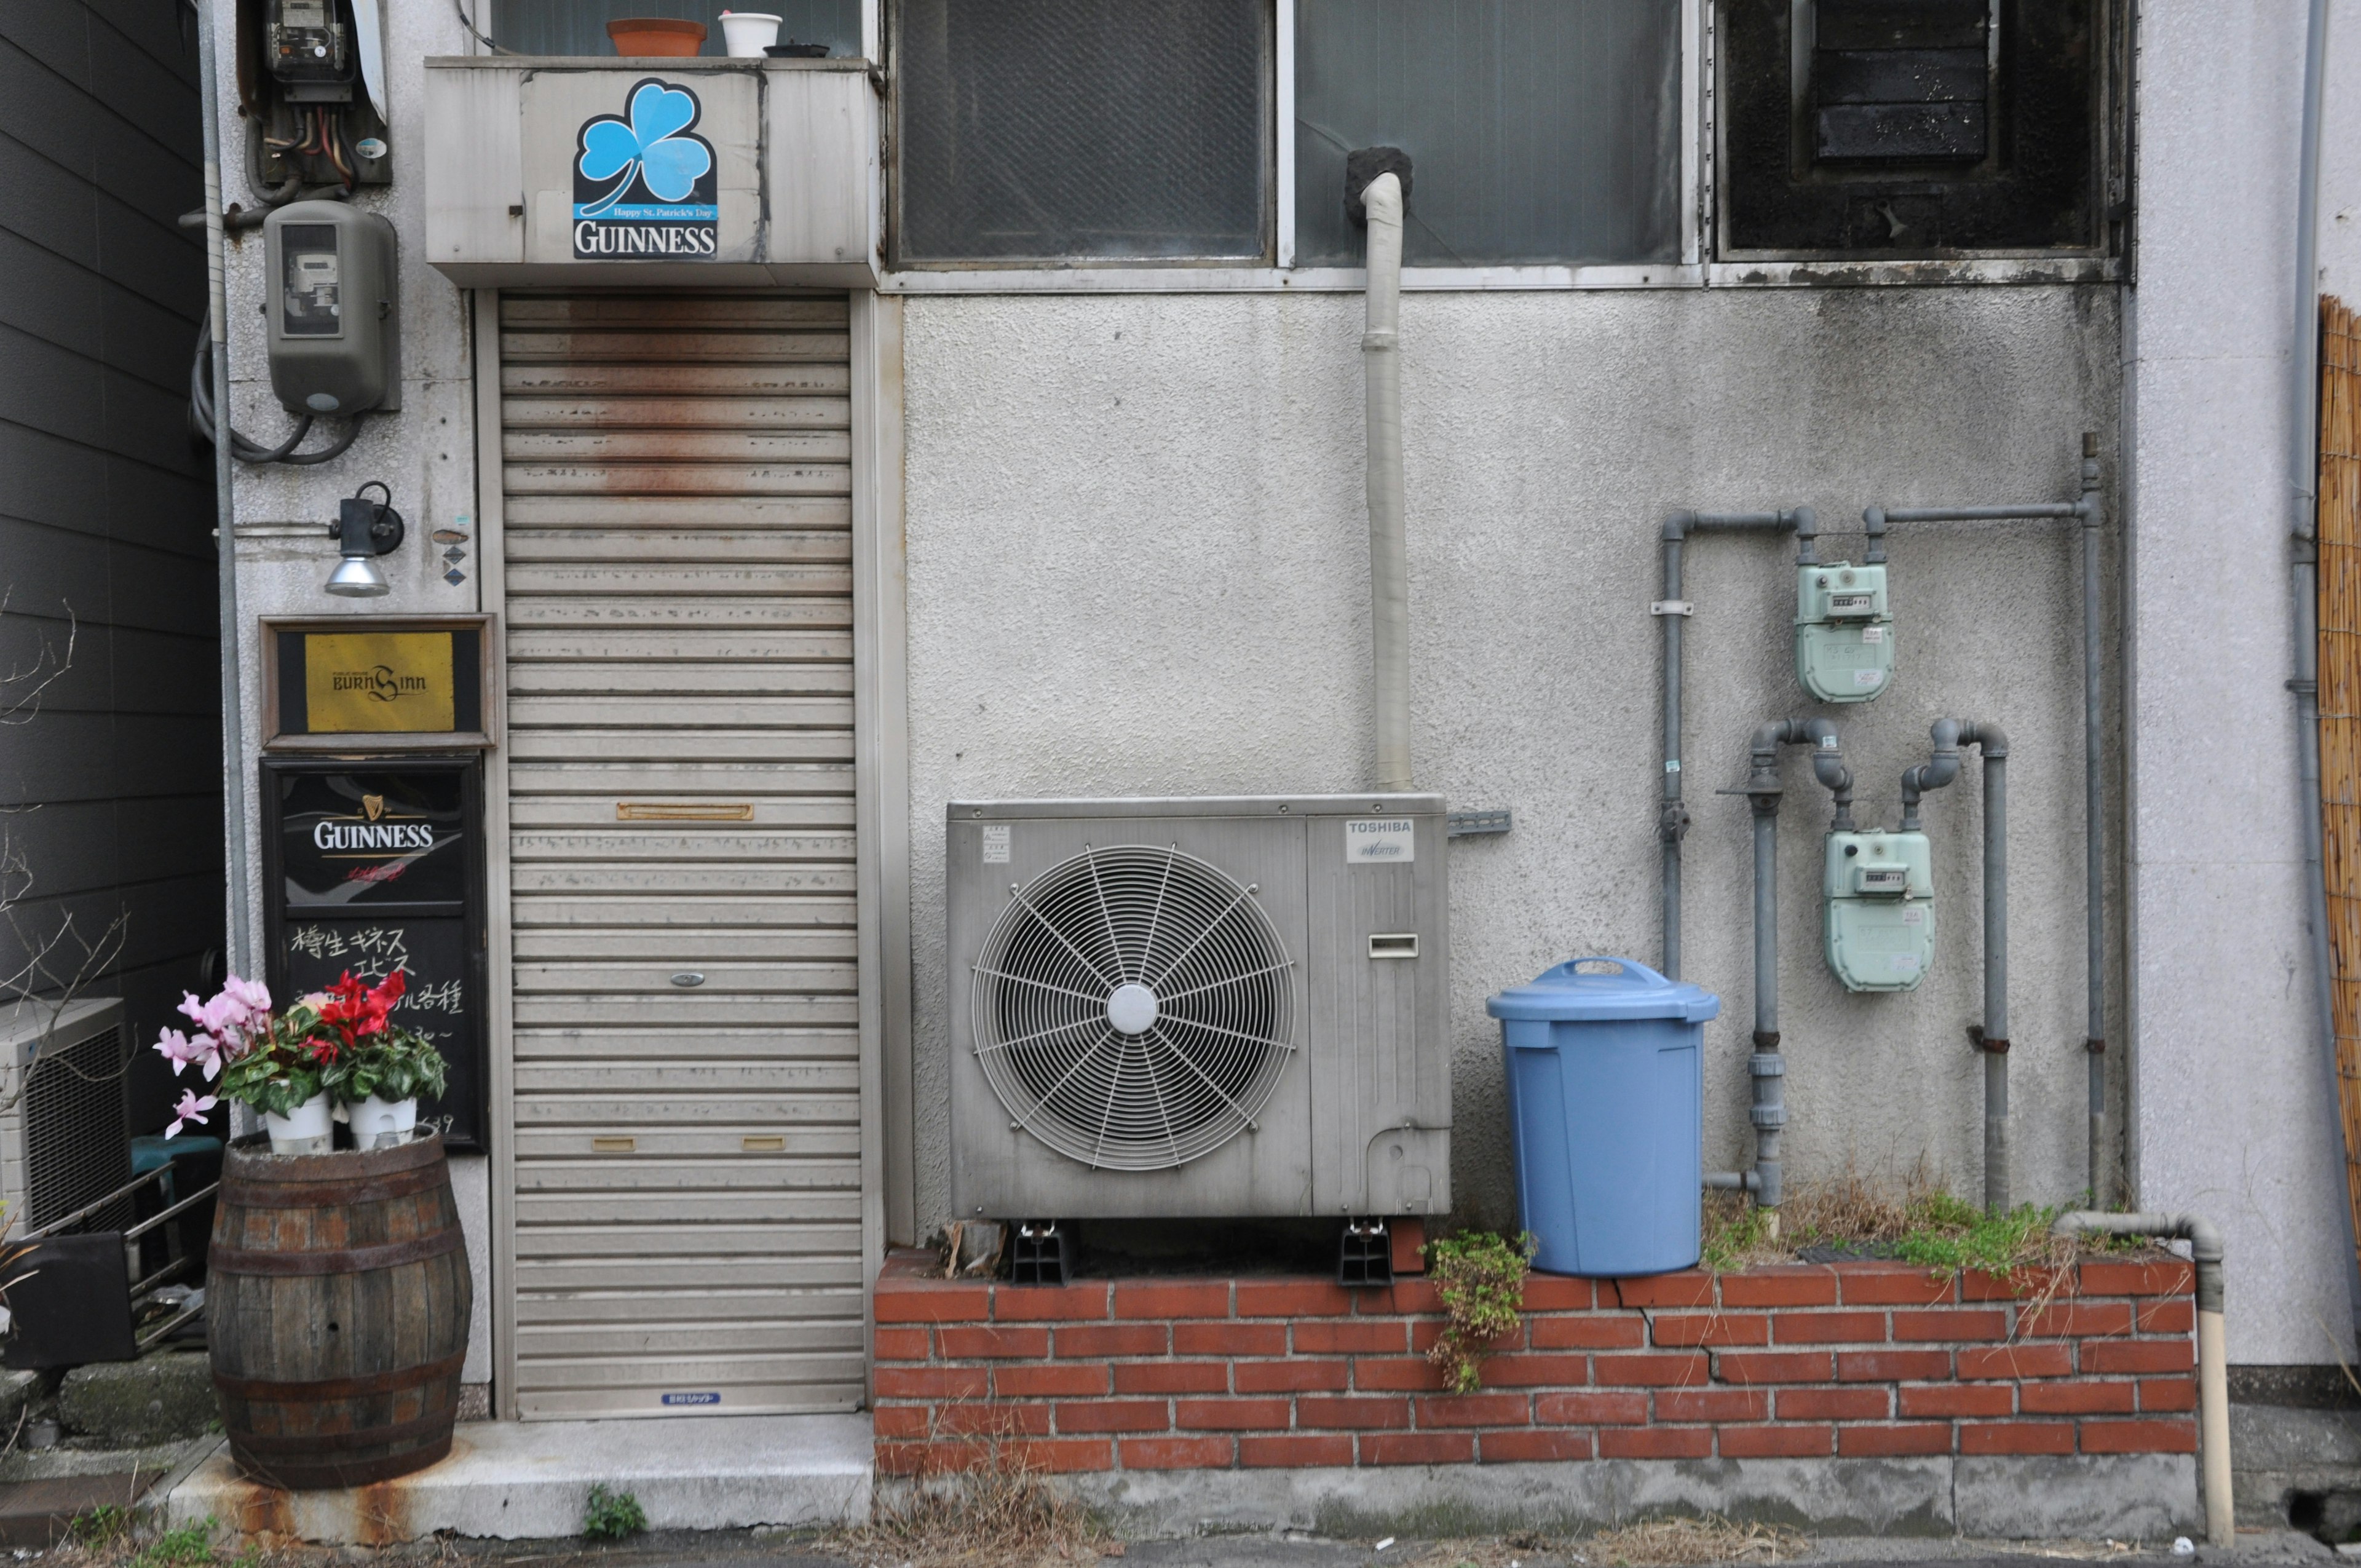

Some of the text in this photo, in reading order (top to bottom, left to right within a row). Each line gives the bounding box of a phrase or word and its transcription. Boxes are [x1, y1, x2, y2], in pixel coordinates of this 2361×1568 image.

[614, 208, 641, 218] Happy
[657, 208, 694, 217] Patrick's
[695, 210, 712, 218] Day
[574, 220, 715, 254] GUINNESS
[314, 822, 433, 850] GUINNESS
[1349, 822, 1410, 833] TOSHIBA
[1361, 838, 1401, 857] INVERTER
[354, 954, 416, 977] エビス
